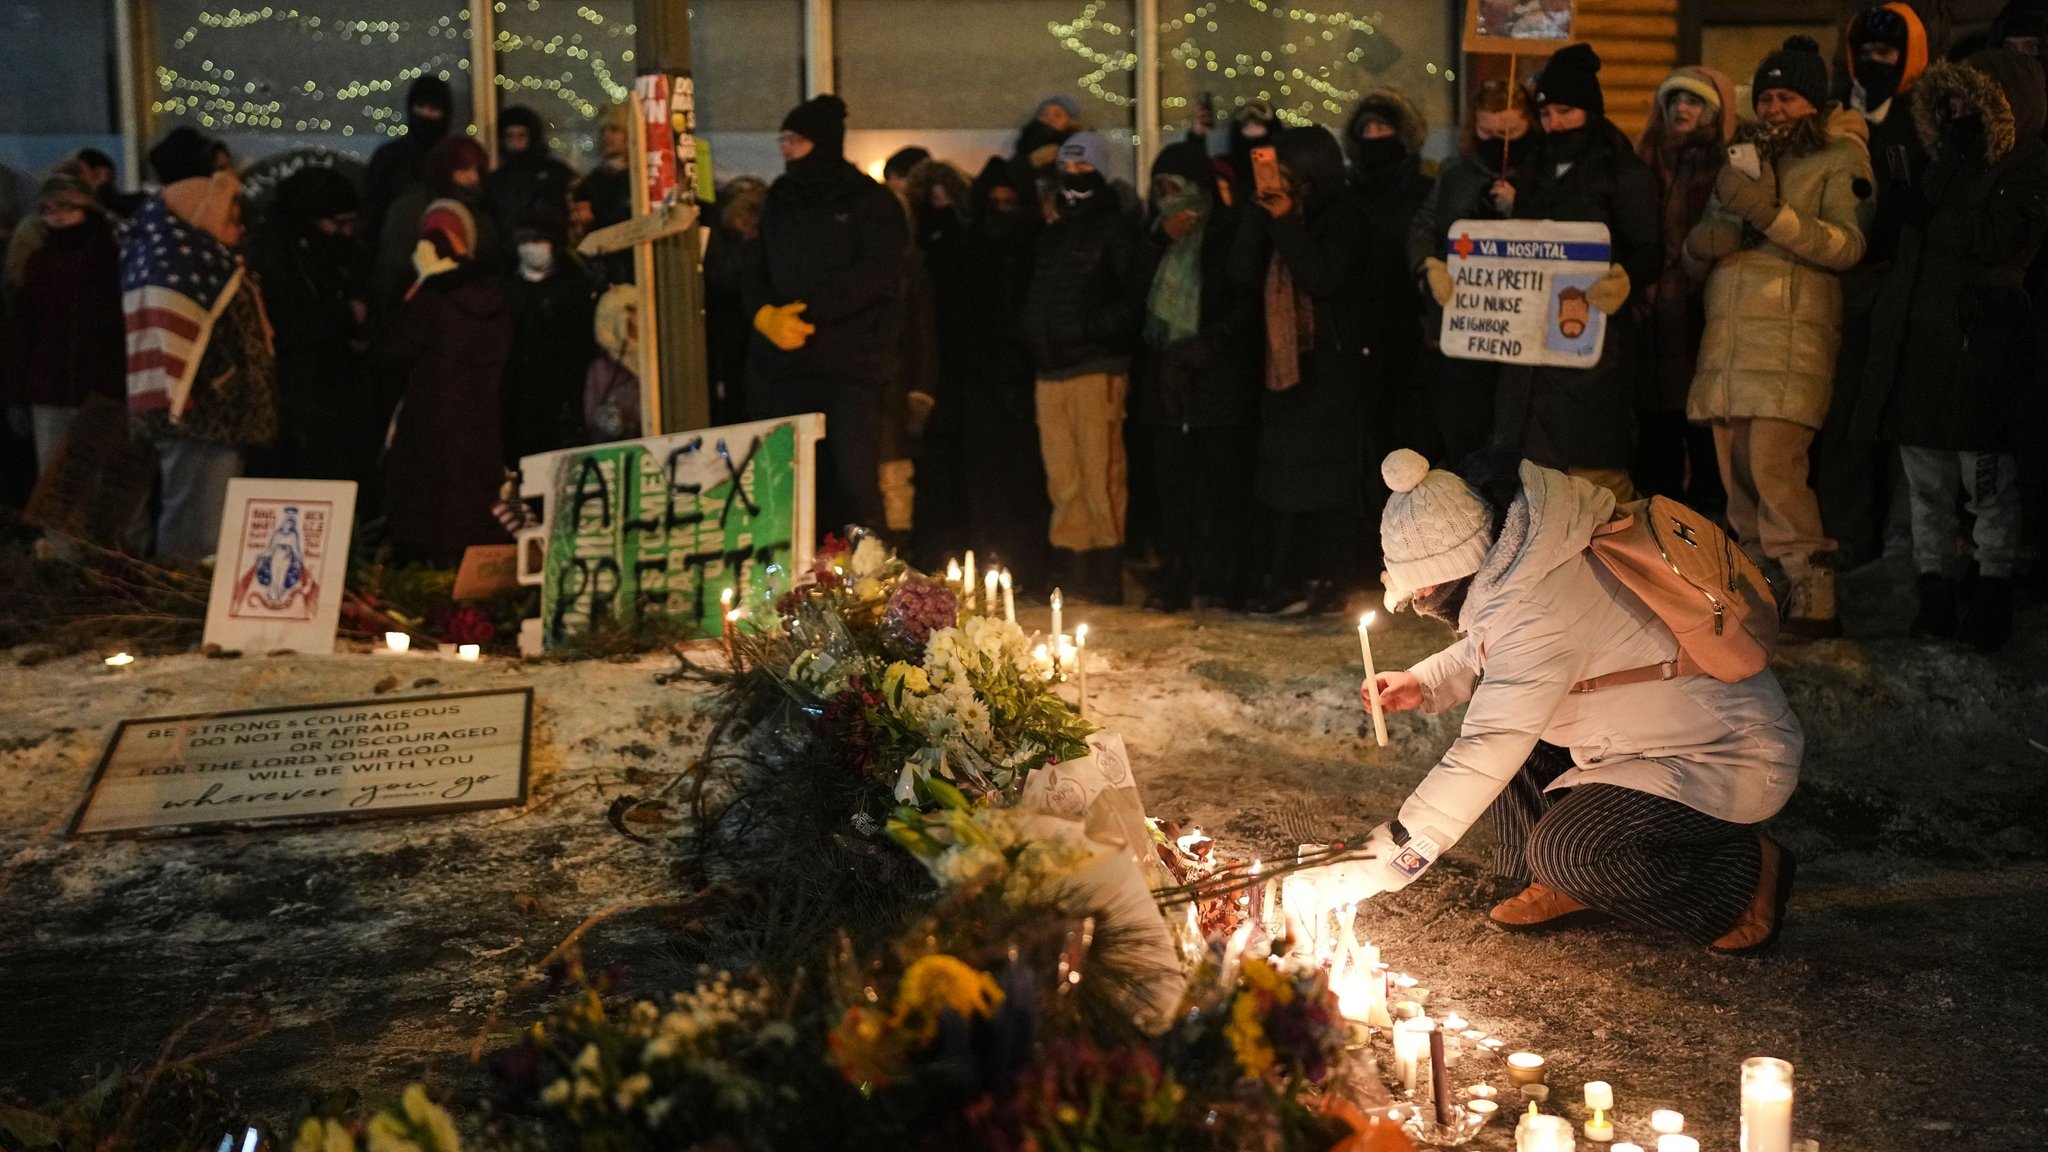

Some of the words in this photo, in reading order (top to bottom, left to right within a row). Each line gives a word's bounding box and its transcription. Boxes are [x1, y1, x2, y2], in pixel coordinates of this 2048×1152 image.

[1480, 240, 1497, 256] VA
[1506, 241, 1568, 259] HOSPITAL
[1456, 266, 1494, 287] ALEX
[1497, 268, 1544, 292] PRETTI
[1456, 293, 1480, 311] ICU
[1484, 294, 1523, 314] NURSE
[1449, 315, 1510, 335] NEIGHBOR
[1468, 336, 1522, 357] FRIEND
[571, 436, 761, 533] ALEX
[147, 728, 177, 739] BE
[186, 719, 281, 738] STRONG
[303, 705, 462, 727] COURAGEOUS
[190, 738, 226, 748] DO
[234, 731, 283, 745] NOT
[291, 728, 319, 740] BE
[328, 721, 410, 738] AFRAID
[290, 742, 323, 752] OR
[331, 726, 498, 750] DISCOURAGED
[139, 765, 187, 777] FOR
[196, 760, 244, 773] THE
[251, 754, 316, 769] LORD
[324, 749, 391, 763] YOUR
[397, 743, 451, 757] GOD
[248, 769, 305, 782] WILL
[314, 765, 344, 777] BE
[352, 759, 416, 774] WITH
[423, 754, 474, 767] YOU
[162, 782, 343, 810] wherever
[348, 778, 439, 808] you
[441, 774, 501, 799] go
